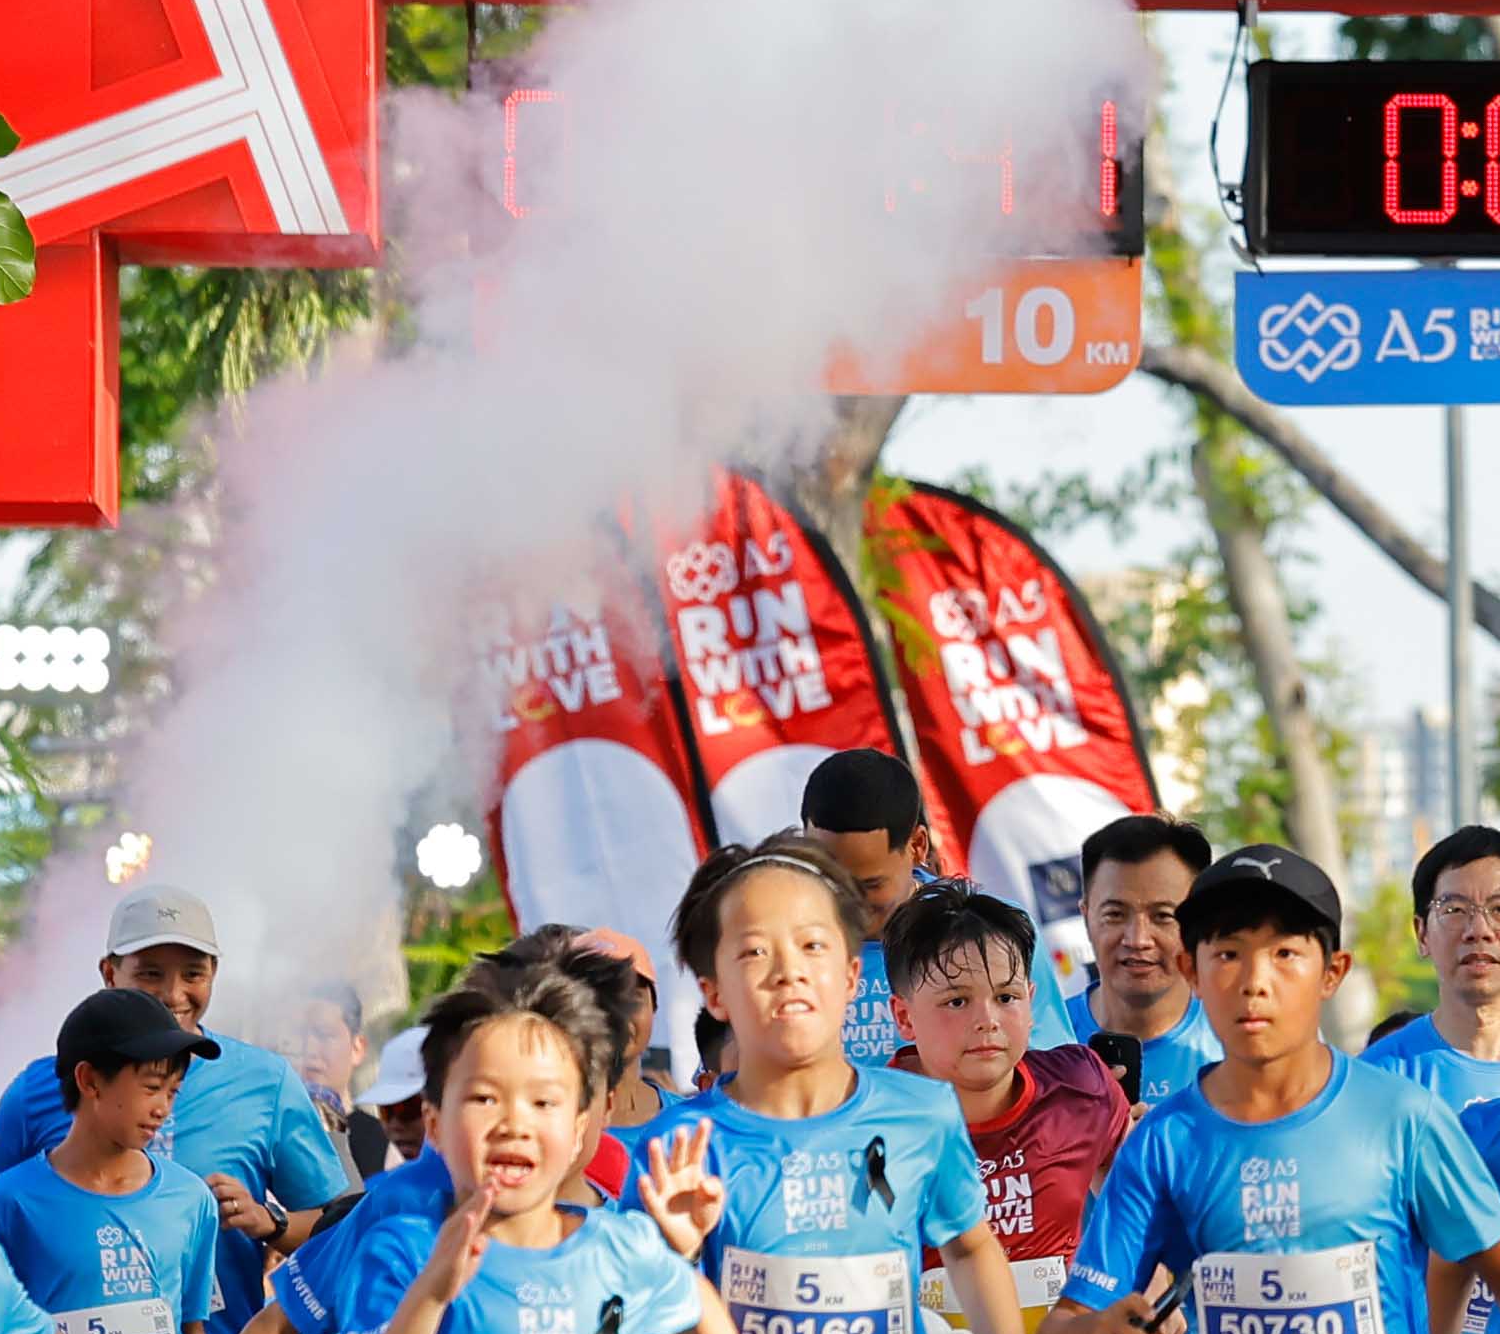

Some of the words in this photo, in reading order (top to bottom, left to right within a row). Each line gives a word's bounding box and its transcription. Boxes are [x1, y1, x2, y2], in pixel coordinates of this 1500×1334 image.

[963, 286, 1076, 366] 10
[1084, 340, 1129, 366] KM
[1375, 308, 1457, 362] A5
[745, 531, 792, 579] A5
[996, 579, 1045, 629] A5
[678, 580, 810, 660] RUN
[687, 635, 822, 695] WITH
[941, 628, 1064, 695] RUN
[696, 670, 832, 736] LOVE
[844, 1001, 895, 1025] RUN
[842, 1024, 894, 1041] WITH
[1145, 1080, 1169, 1096] A5
[1001, 1150, 1025, 1171] A5
[782, 1174, 844, 1203] RUN
[1242, 1182, 1298, 1209] RUN
[785, 1198, 845, 1217] WITH
[1243, 1206, 1299, 1224] WITH
[786, 1215, 848, 1235] LOVE
[100, 1248, 148, 1268] RUN
[102, 1268, 150, 1282] WITH
[1201, 1266, 1234, 1281] RUN
[1260, 1270, 1283, 1301] 5
[1287, 1292, 1307, 1301] KM
[102, 1282, 152, 1296] LOVE
[291, 1276, 326, 1321] FUTURE
[796, 1273, 820, 1304] 5
[824, 1296, 844, 1306] KM
[1203, 1282, 1235, 1292] WITH
[517, 1307, 576, 1332] RUN
